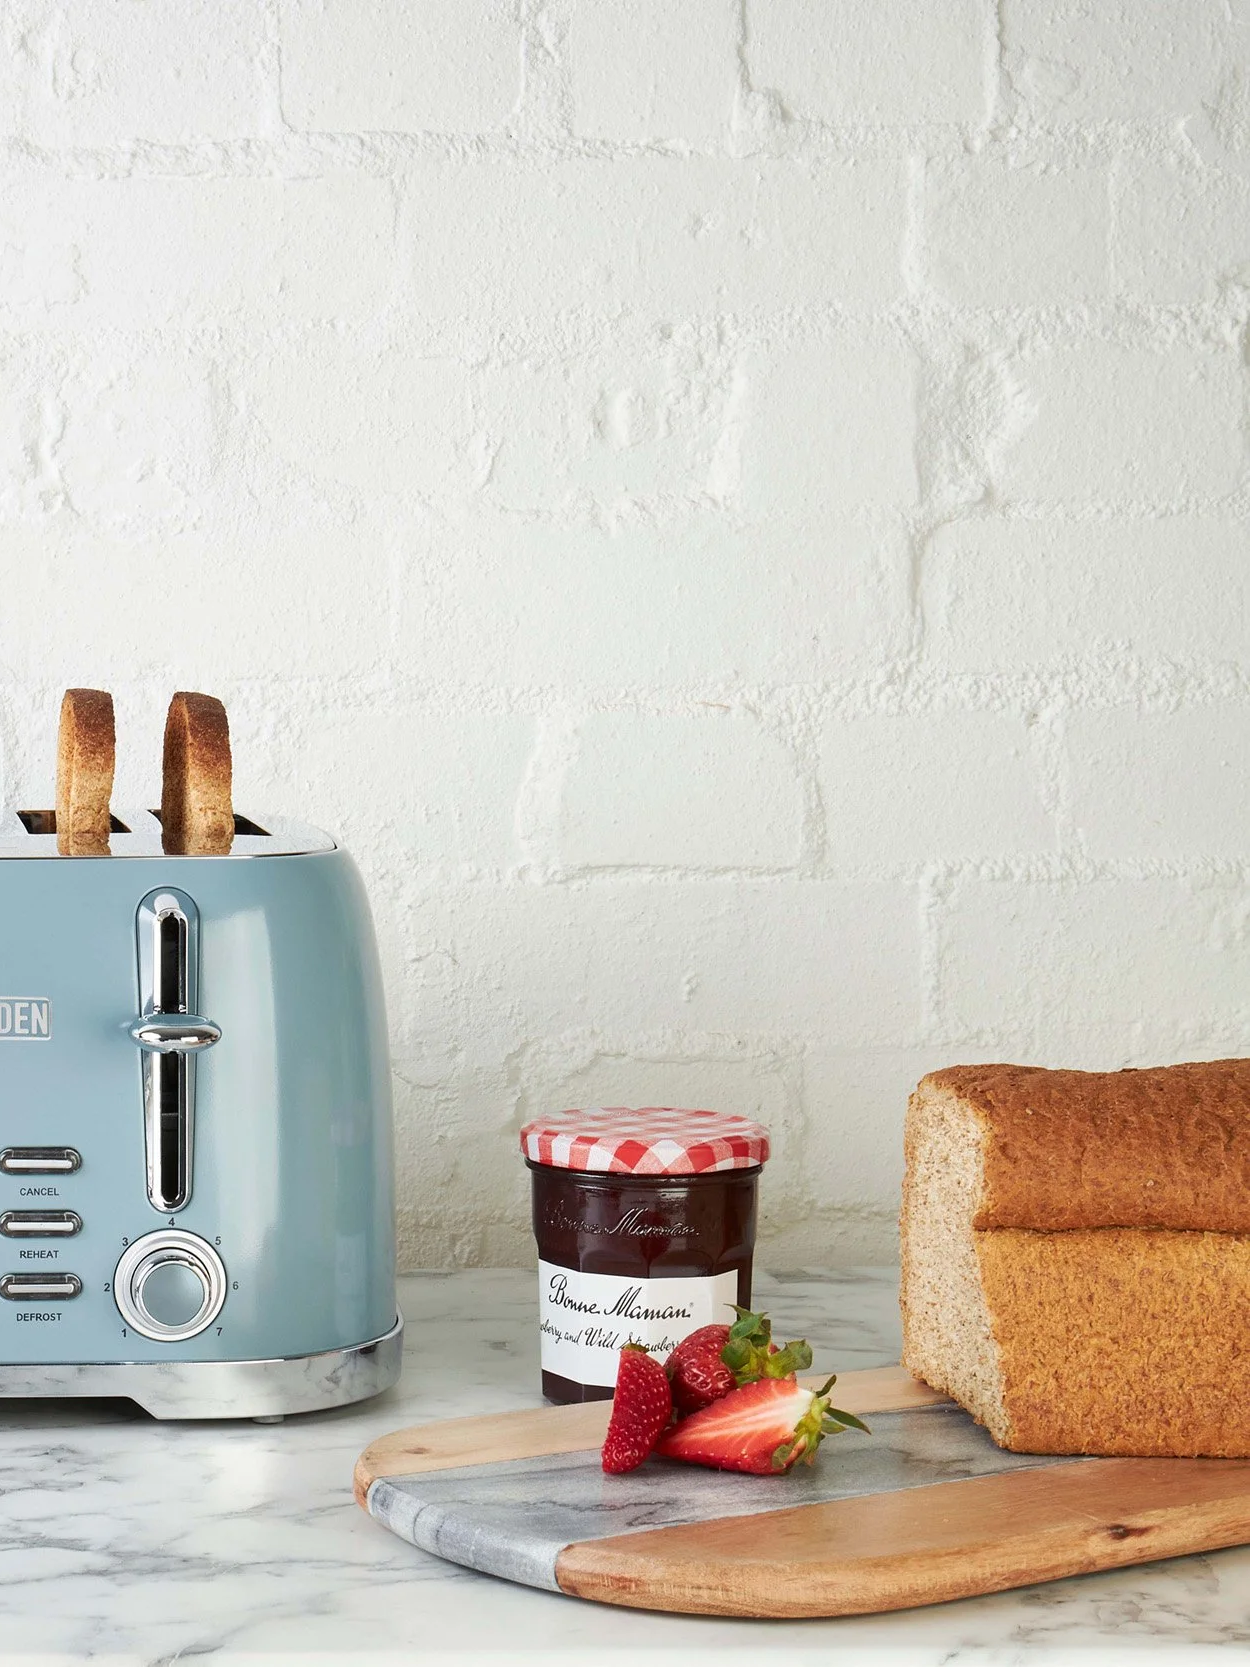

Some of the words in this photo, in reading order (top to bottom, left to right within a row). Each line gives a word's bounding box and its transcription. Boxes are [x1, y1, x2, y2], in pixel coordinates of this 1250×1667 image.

[19, 1187, 60, 1197] CANCEL
[168, 1216, 176, 1227] 4
[122, 1237, 129, 1247] 3
[214, 1236, 222, 1246] 5
[19, 1249, 59, 1259] REHEAT
[103, 1282, 111, 1292] 2
[232, 1281, 239, 1291] 6
[548, 1273, 600, 1315] Bonne
[16, 1312, 62, 1322] DEFROST
[216, 1327, 223, 1337] 7
[564, 1329, 583, 1345] and
[584, 1327, 620, 1350] Wild
